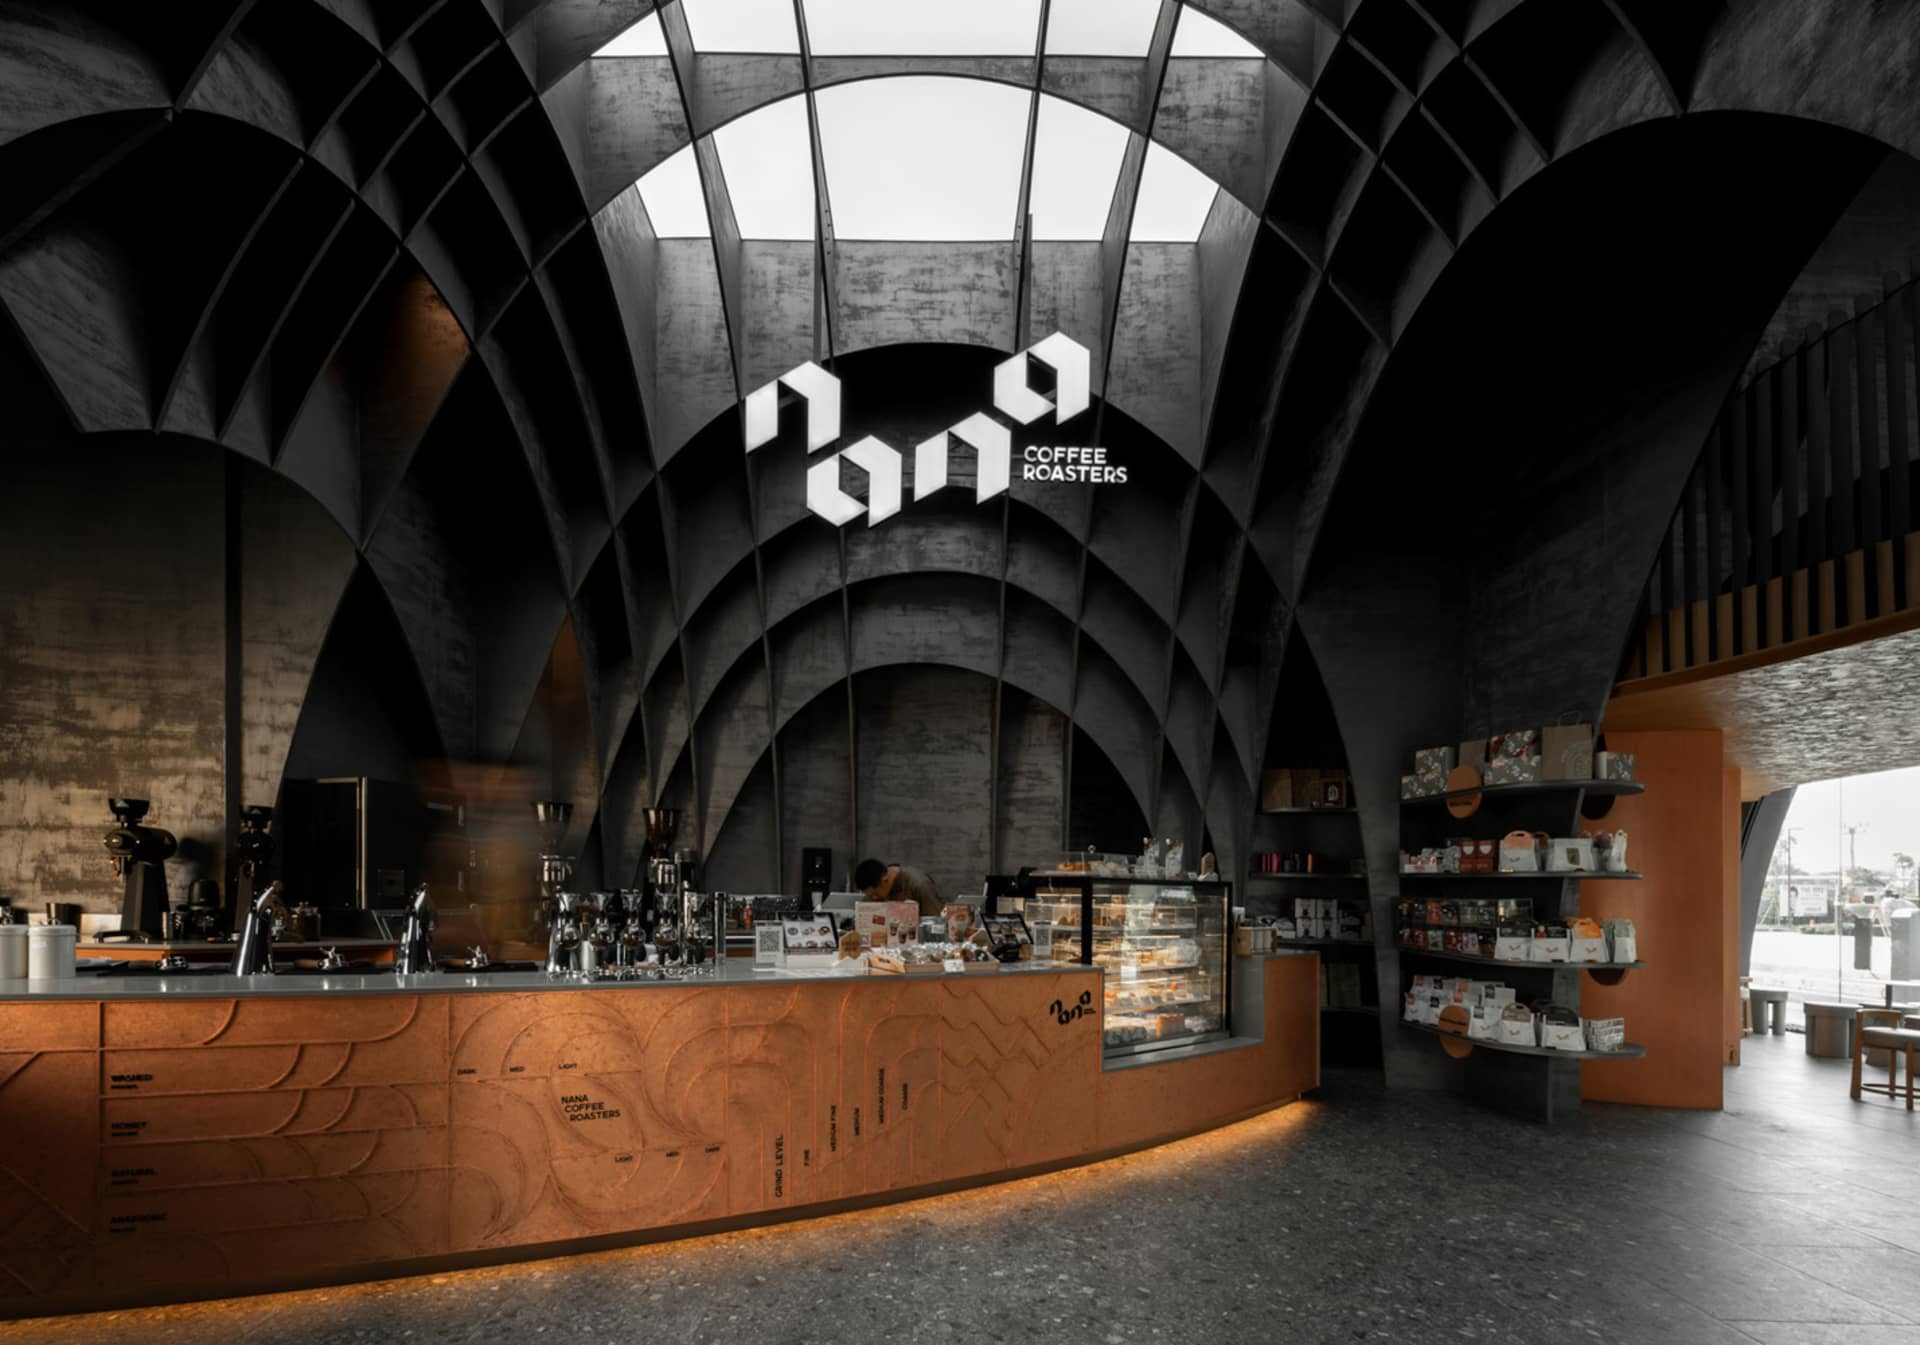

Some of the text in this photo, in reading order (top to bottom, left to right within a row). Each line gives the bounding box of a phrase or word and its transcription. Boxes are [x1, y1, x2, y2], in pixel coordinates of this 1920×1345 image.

[745, 331, 1090, 527] nana
[1024, 445, 1107, 464] COFFEE
[1023, 464, 1128, 483] ROASTERS
[561, 1094, 589, 1104] NANA
[564, 1102, 605, 1113] COFFEE
[569, 1109, 621, 1121] ROASTERS
[775, 1135, 784, 1198] GRIND LEVEL
